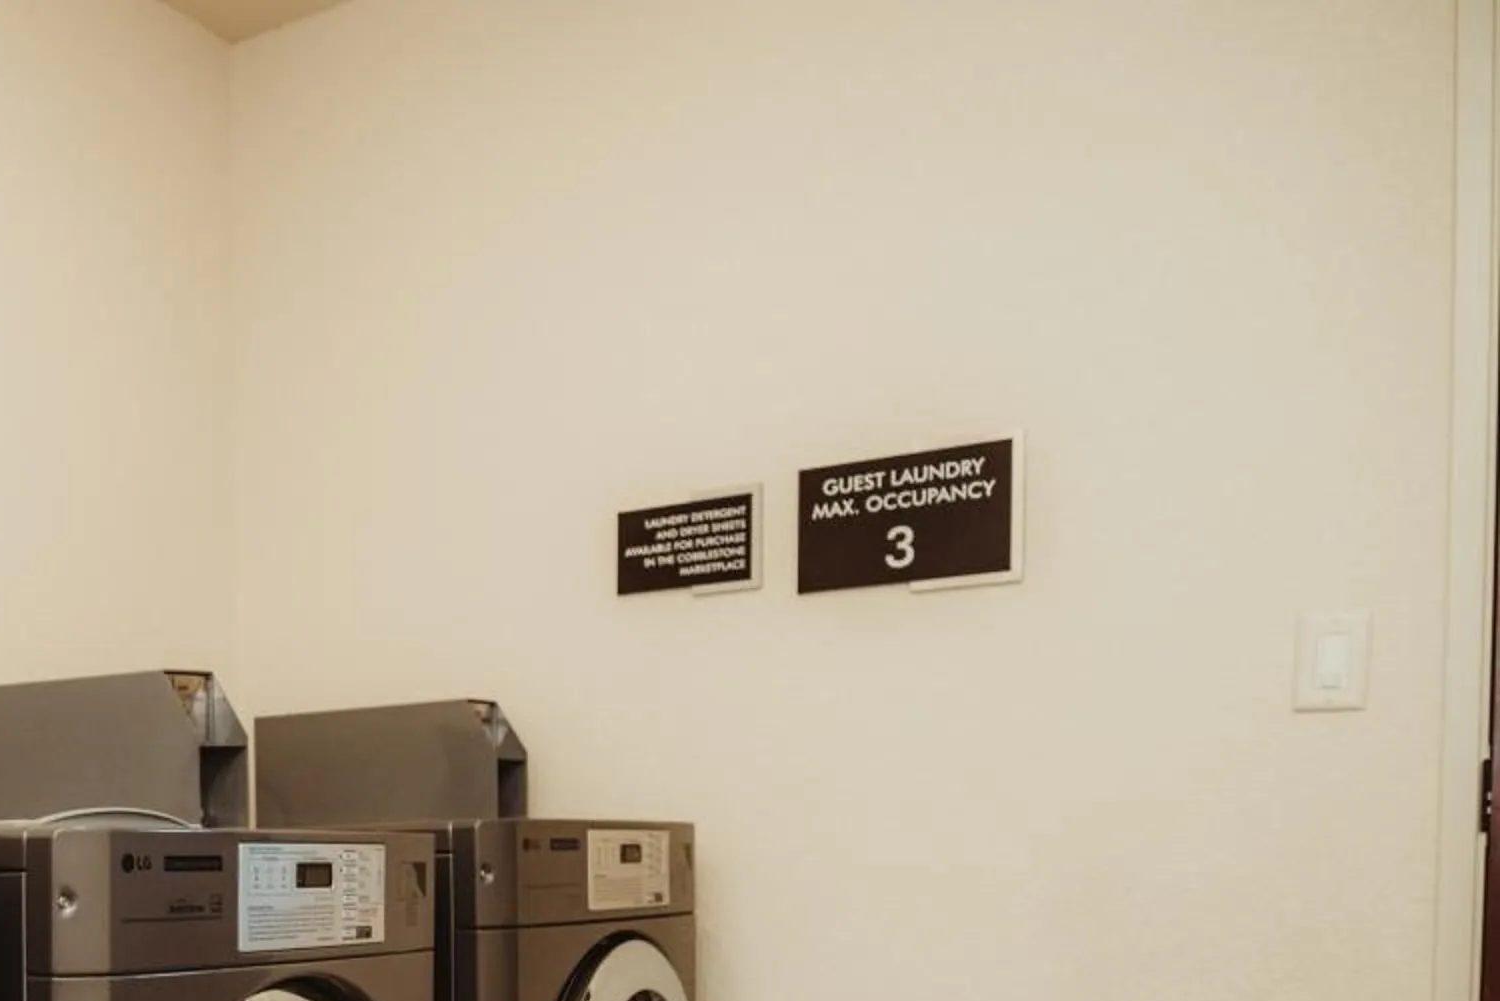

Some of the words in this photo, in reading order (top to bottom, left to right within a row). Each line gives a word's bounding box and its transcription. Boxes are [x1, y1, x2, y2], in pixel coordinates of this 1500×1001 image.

[822, 471, 886, 496] GUEST
[890, 456, 986, 487] LAUNDRY
[811, 498, 860, 521] MAX.
[865, 478, 997, 513] OCCUPANCY
[644, 514, 689, 530] LAUNDRY
[691, 505, 746, 522] DETERGENT
[655, 527, 679, 541] AND
[680, 523, 709, 537] DRYER
[711, 518, 746, 533] SHEETS
[625, 541, 672, 558] AVAILABLE
[673, 539, 693, 550] FOR
[695, 532, 746, 548] PURCHASE
[643, 556, 656, 568] IN
[658, 554, 674, 566] THE
[676, 545, 746, 564] COBBLESTONE
[884, 524, 915, 569] 3
[679, 558, 746, 576] MARKETPLACE
